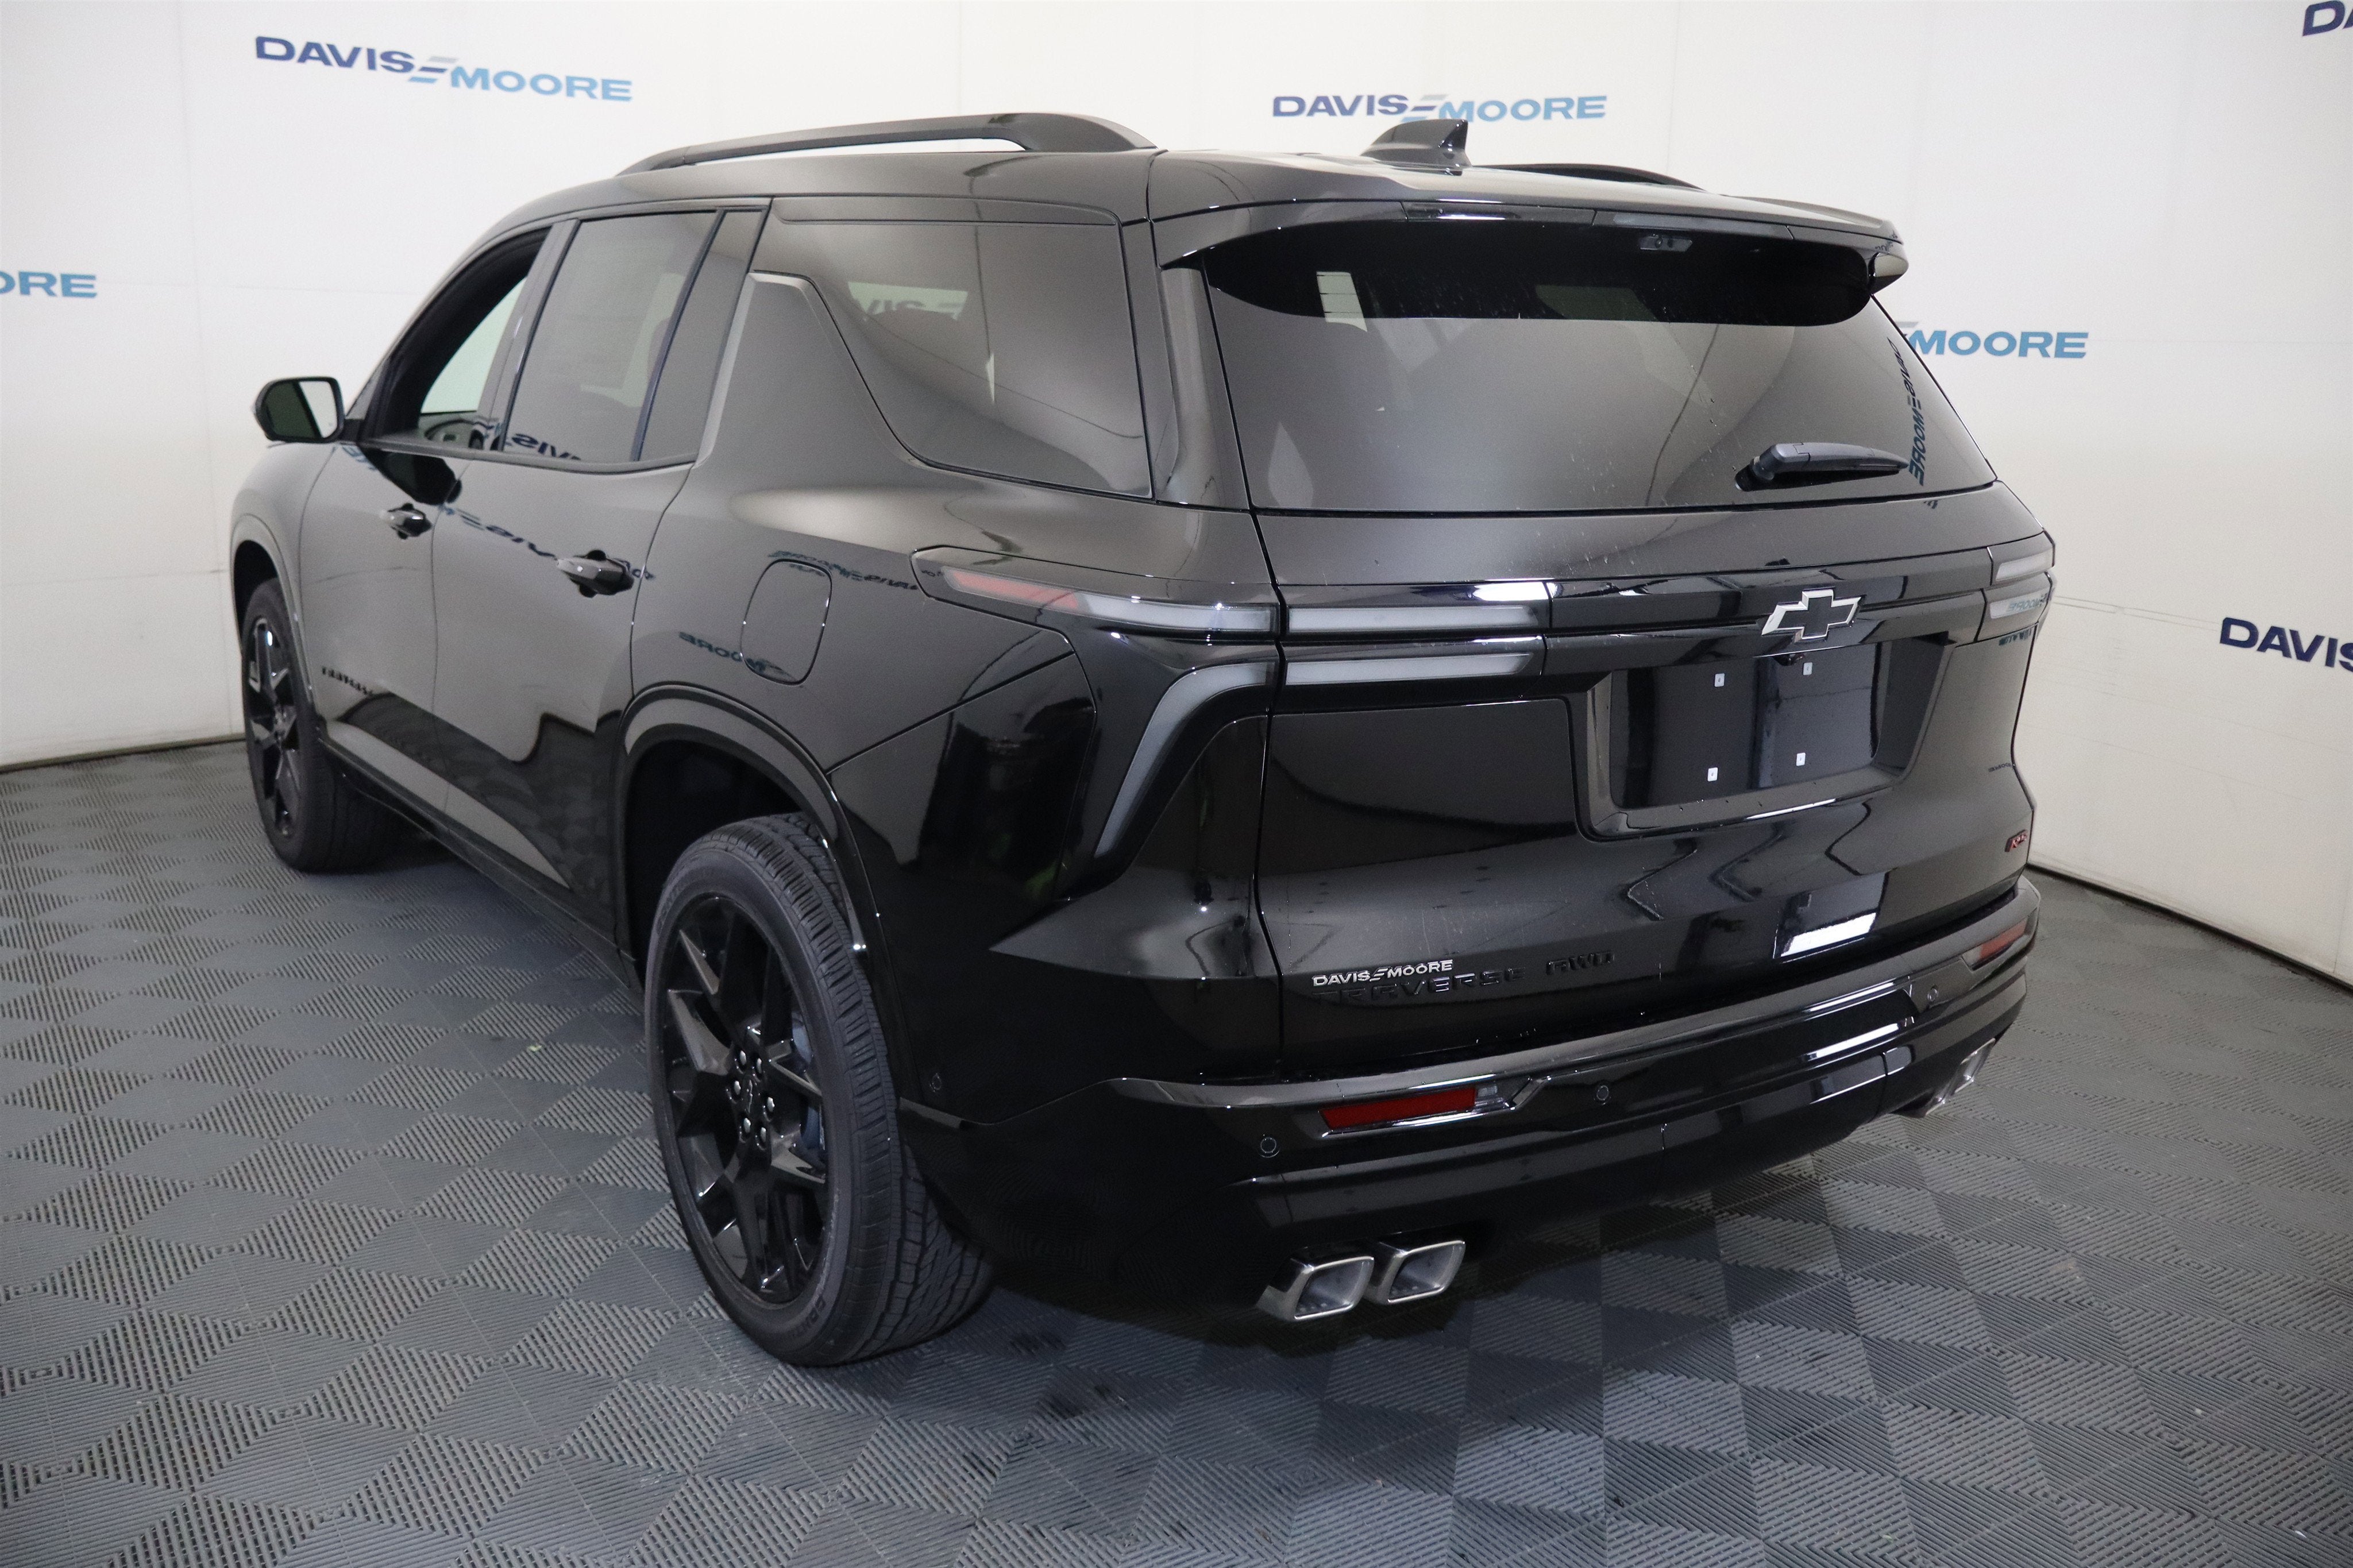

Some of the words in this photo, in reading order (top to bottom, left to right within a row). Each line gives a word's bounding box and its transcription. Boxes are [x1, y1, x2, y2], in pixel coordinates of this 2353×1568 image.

[2302, 1, 2353, 36] D
[256, 36, 415, 73] DAVIS
[450, 65, 632, 102] MOORE
[1272, 94, 1410, 117] DAVIS
[1438, 95, 1607, 122] MOORE
[1907, 330, 2089, 359] MOORE
[1312, 971, 1371, 987] DAVIS
[1387, 959, 1453, 979] MOORE
